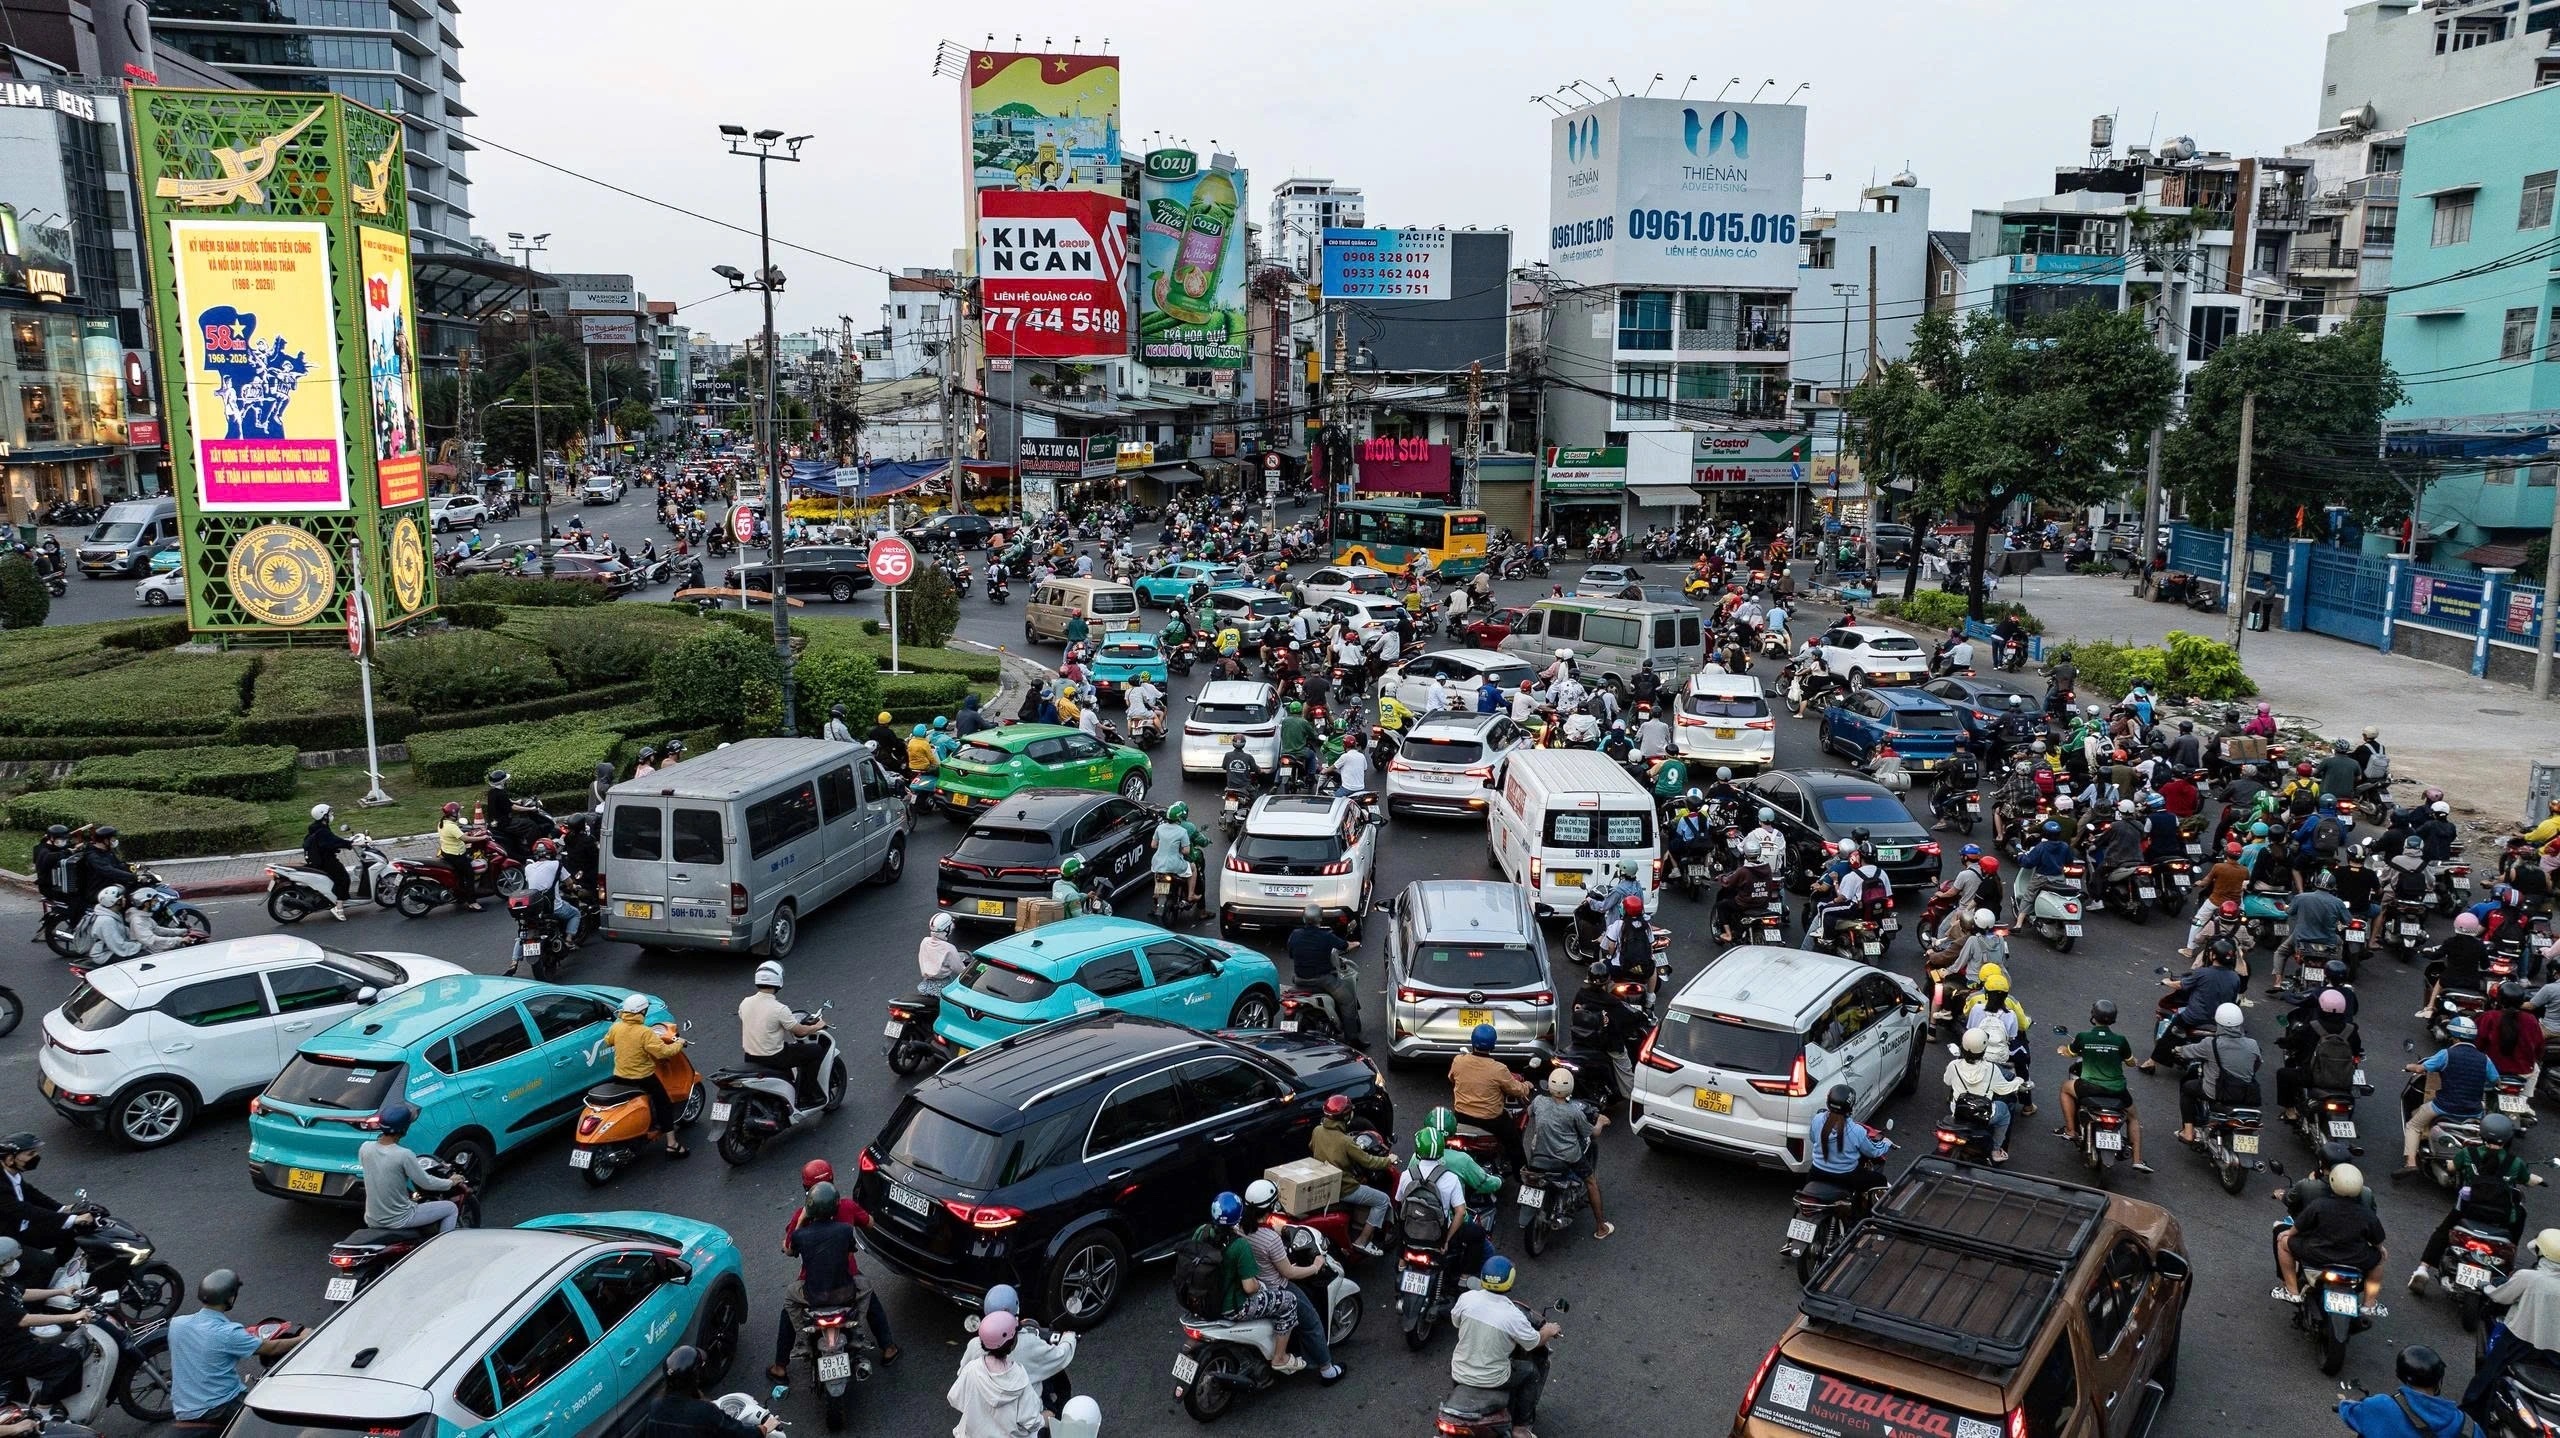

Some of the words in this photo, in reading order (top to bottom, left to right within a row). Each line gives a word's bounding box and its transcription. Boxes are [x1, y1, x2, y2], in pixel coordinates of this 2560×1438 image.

[58, 89, 94, 120] IELTS
[1150, 155, 1191, 173] Cozy
[1567, 184, 1599, 199] ADVERTISING
[1682, 182, 1747, 193] ADVERTISING
[1156, 209, 1184, 228] Mới
[1193, 216, 1220, 234] Cozy
[1629, 209, 1796, 244] 0961.015.016
[993, 228, 1056, 248] KIM
[1399, 233, 1445, 241] PACIFIC
[1552, 216, 1614, 250] 0961.015.016
[1059, 240, 1090, 248] GROUP
[1665, 244, 1684, 256] LIÊN
[1687, 246, 1698, 259] HỆ
[1700, 244, 1734, 258] QUẢNG
[1736, 246, 1757, 258] CÁO
[208, 257, 218, 272] VÀ
[994, 250, 1092, 272] NGAN
[1343, 253, 1375, 262] 0908
[1379, 253, 1402, 262] 328
[1406, 254, 1430, 263] 017
[1343, 269, 1375, 278] 0933
[1379, 269, 1402, 278] 462
[1406, 270, 1430, 279] 404
[994, 290, 1016, 301] LIÊN
[1017, 290, 1030, 302] HỆ
[1032, 290, 1068, 302] QUẢNG
[1070, 290, 1092, 302] CÁO
[1343, 284, 1375, 293] 0977
[1379, 284, 1402, 293] 755
[1406, 284, 1430, 294] 751
[205, 324, 232, 350] 58
[1164, 326, 1180, 341] TRÀ
[1184, 330, 1202, 342] HOA
[1206, 324, 1226, 342] QUẢ
[1146, 344, 1168, 357] NGON
[1218, 344, 1240, 358] NGON
[1021, 440, 1036, 456] SỬA
[1039, 444, 1049, 456] XE
[1051, 444, 1064, 456] TAY
[1066, 446, 1079, 457] GA
[1364, 435, 1394, 460] NÓN
[1399, 436, 1428, 460] SƠN
[1714, 439, 1749, 448] Castrol
[1696, 465, 1724, 481] TẤN
[737, 518, 751, 536] 5G
[875, 554, 907, 576] 5G
[348, 615, 360, 645] 5G
[1668, 768, 1678, 785] 9
[1114, 855, 1127, 874] GF
[1128, 844, 1143, 867] VIP
[1575, 849, 1620, 858] 50H-839.06
[671, 908, 716, 919] 50H-670.35
[1706, 1089, 1722, 1100] 50E
[1698, 1099, 1727, 1112] 097.78
[299, 1172, 313, 1181] 50H
[292, 1180, 318, 1192] 524.98
[890, 1186, 928, 1213] 51H-298.98
[2462, 1266, 2485, 1279] 59-E1
[654, 1322, 669, 1338] XANH
[823, 1356, 845, 1369] 59-Y2
[821, 1366, 849, 1379] 808.15
[572, 1396, 587, 1413] 1900
[587, 1382, 604, 1400] 2088
[1754, 1411, 1772, 1421] Makita
[1772, 1415, 1802, 1429] Authorized
[1802, 1424, 1820, 1435] Service
[1755, 1406, 1772, 1416] TRUNG
[1773, 1410, 1784, 1419] TÂM
[1784, 1412, 1793, 1422] BẢO
[1794, 1416, 1808, 1426] HÀNH
[1809, 1421, 1825, 1432] CHÍNH
[1825, 1426, 1841, 1437] HÃNG
[1811, 1403, 1870, 1431] NaviTech
[382, 1429, 401, 1437] TAXI
